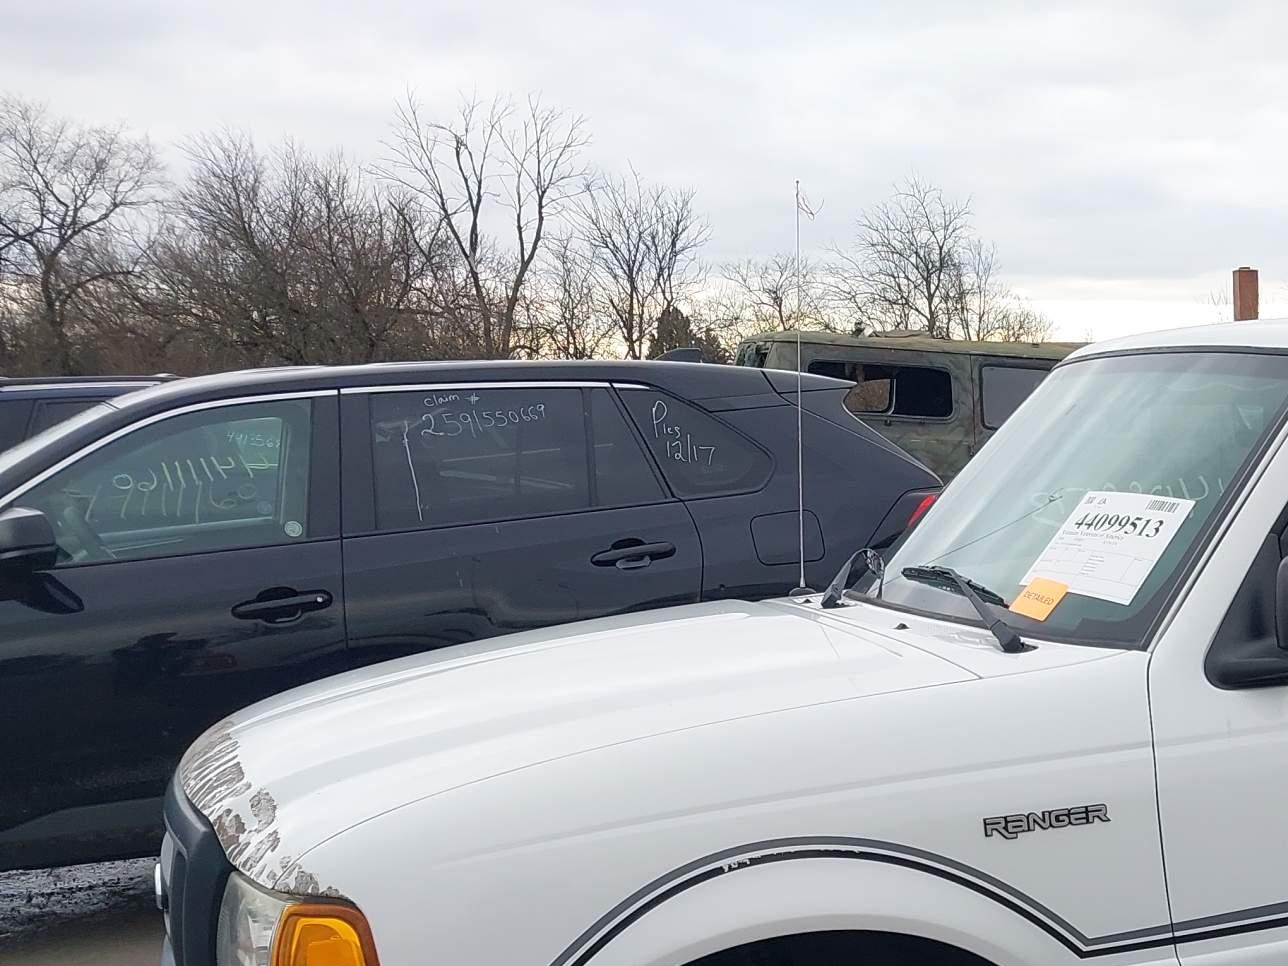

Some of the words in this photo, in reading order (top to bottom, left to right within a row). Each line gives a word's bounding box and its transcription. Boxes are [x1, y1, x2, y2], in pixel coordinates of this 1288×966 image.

[667, 434, 716, 465] 12/17
[1074, 511, 1164, 538] 44099513
[1022, 590, 1055, 606] DETAILED
[983, 803, 1111, 840] RANGER
